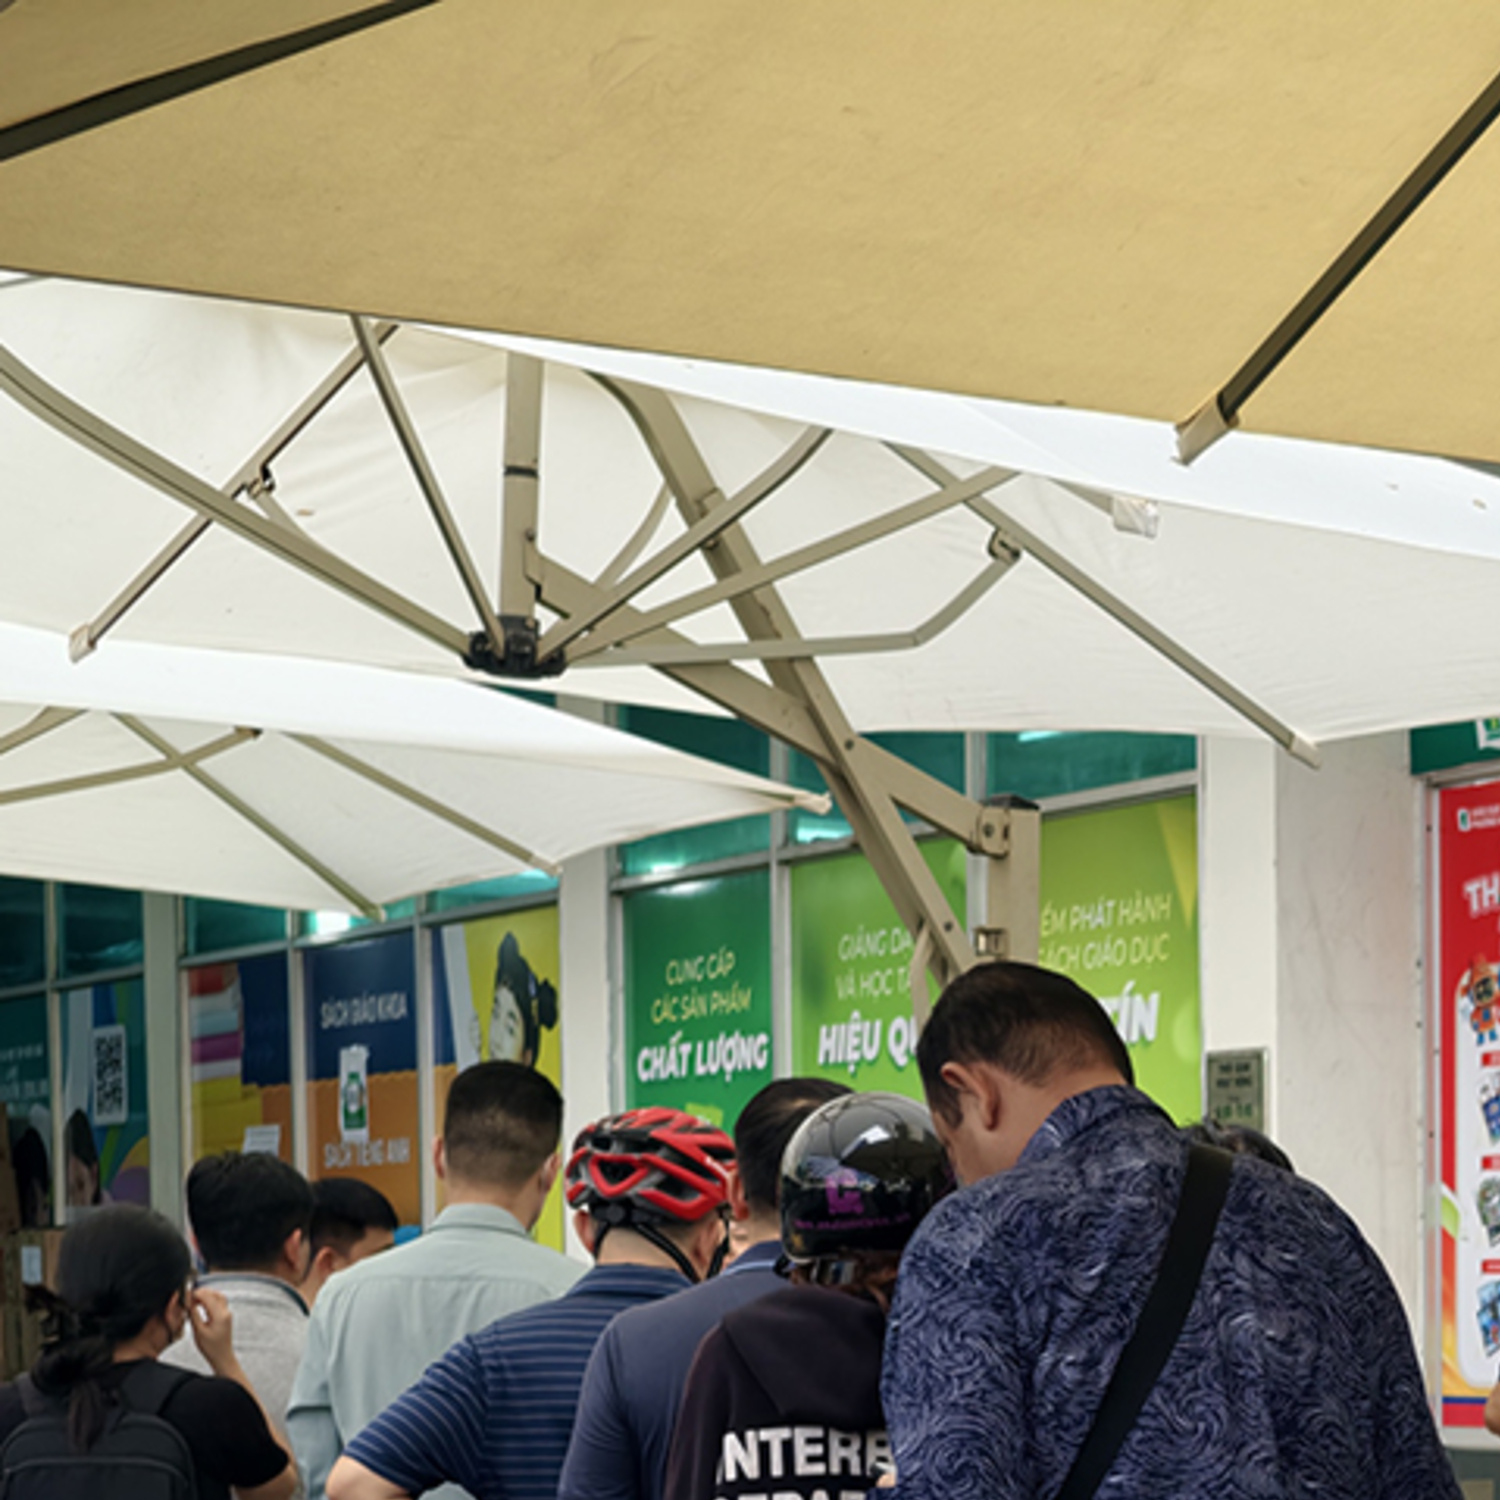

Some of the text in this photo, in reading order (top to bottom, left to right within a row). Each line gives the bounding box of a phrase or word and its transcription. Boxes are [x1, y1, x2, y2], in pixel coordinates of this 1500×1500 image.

[1069, 895, 1116, 933] PHÁT
[1117, 889, 1172, 926] HÀNH
[665, 954, 704, 986] CUNG
[1081, 934, 1127, 970] GIÁO
[636, 1029, 769, 1082] CHẤT LƯỢNG
[817, 1009, 882, 1073] HIỆU
